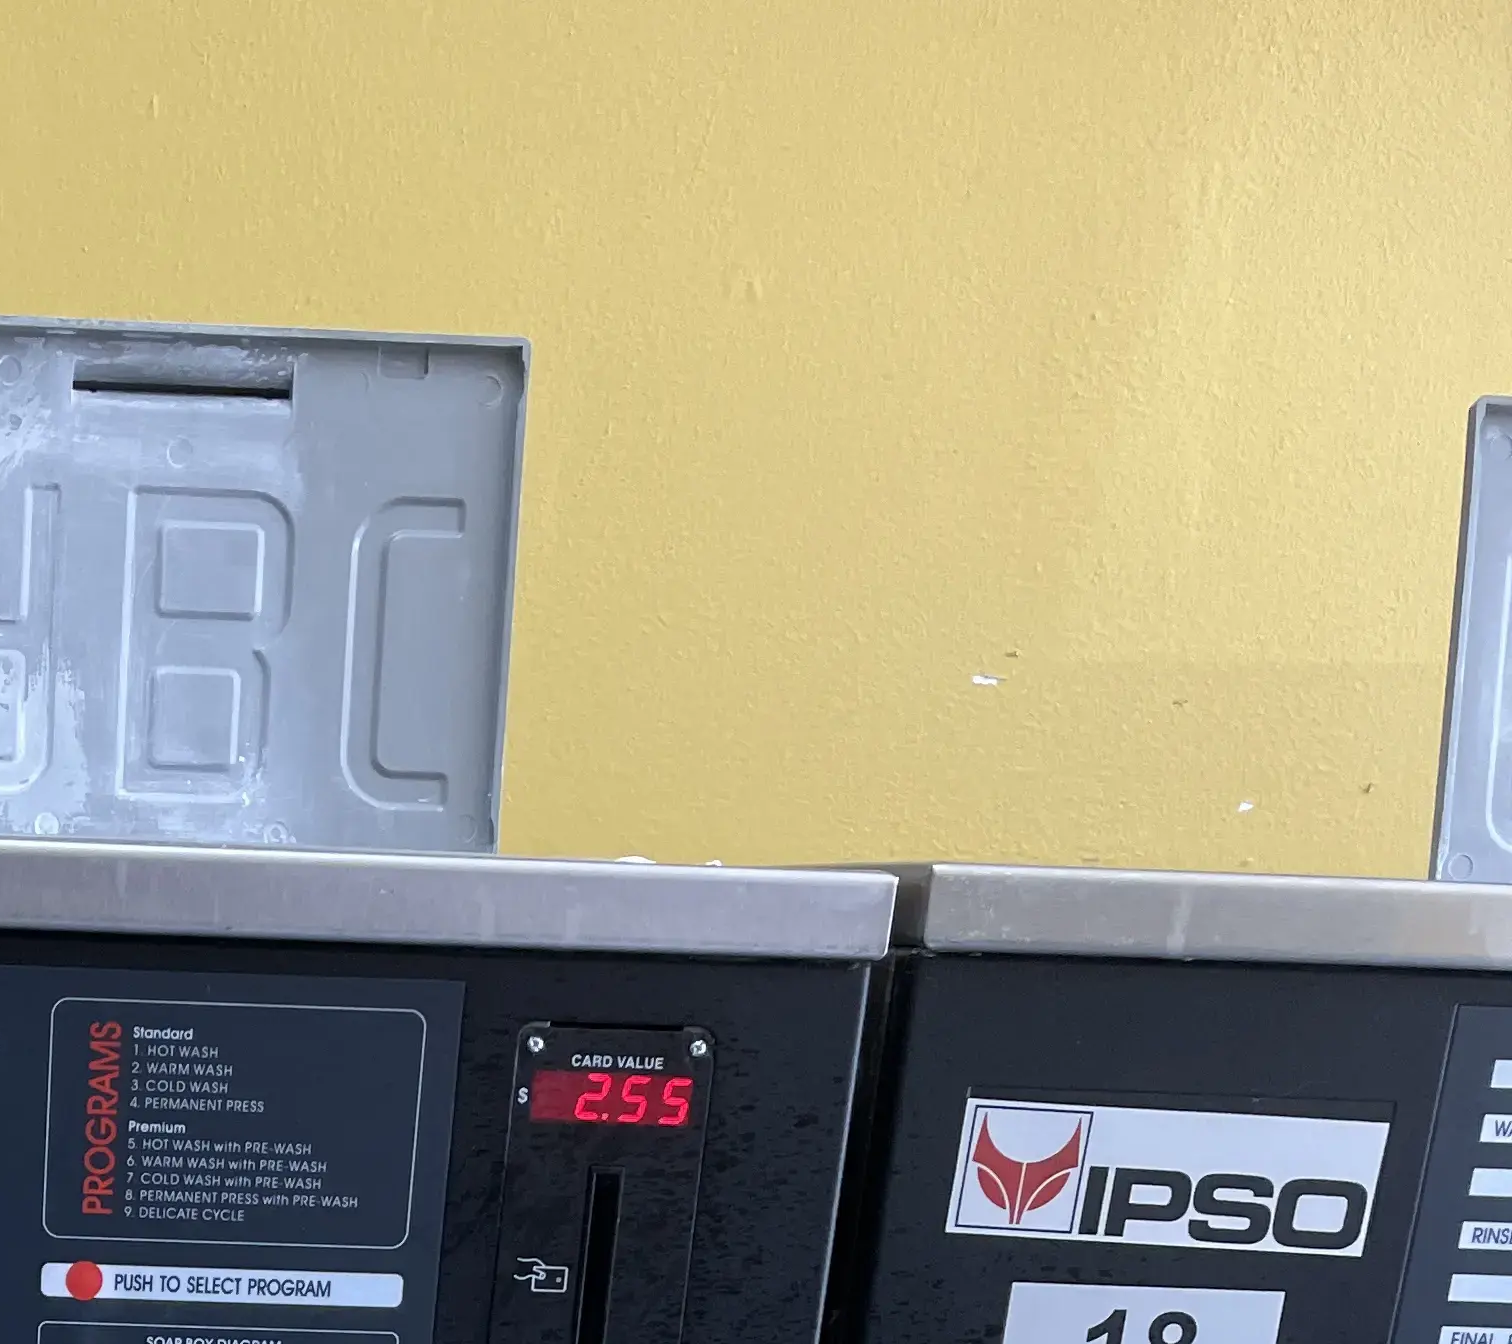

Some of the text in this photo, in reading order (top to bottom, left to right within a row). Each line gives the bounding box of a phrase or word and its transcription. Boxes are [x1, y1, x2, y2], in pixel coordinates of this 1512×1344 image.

[132, 1025, 194, 1041] Standard
[147, 1044, 176, 1058] HOT
[178, 1045, 220, 1059] WASH
[146, 1062, 190, 1076] WARM
[193, 1063, 234, 1077] WASH
[571, 1054, 664, 1070] CARD VALUE
[145, 1079, 186, 1093] COLD
[189, 1080, 229, 1094] WASH
[129, 1096, 266, 1113] 4. PERMANENT PRESS
[518, 1072, 694, 1126] $ 2.55
[81, 1020, 123, 1216] PROGRAMS
[127, 1120, 187, 1135] Premium
[142, 1138, 169, 1152] HOT
[172, 1139, 211, 1153] WASH
[213, 1141, 241, 1153] with
[244, 1141, 313, 1155] PRE-WASH
[141, 1155, 184, 1169] WARM
[187, 1157, 226, 1171] WASH
[228, 1158, 256, 1171] with
[259, 1159, 328, 1173] PRE-WASH
[140, 1172, 180, 1186] COLD
[183, 1174, 221, 1188] WASH
[223, 1175, 252, 1188] with
[255, 1176, 322, 1190] PRE-WASH
[139, 1189, 218, 1204] PERMANENT
[220, 1192, 260, 1205] PRESS
[262, 1193, 290, 1206] with
[292, 1194, 359, 1209] PRE-WASH
[138, 1206, 199, 1221] DELICATE
[201, 1208, 246, 1222] CYCLE
[1077, 1165, 1369, 1251] IPSO
[113, 1273, 332, 1299] PUSH TO SELECT PROGRAM
